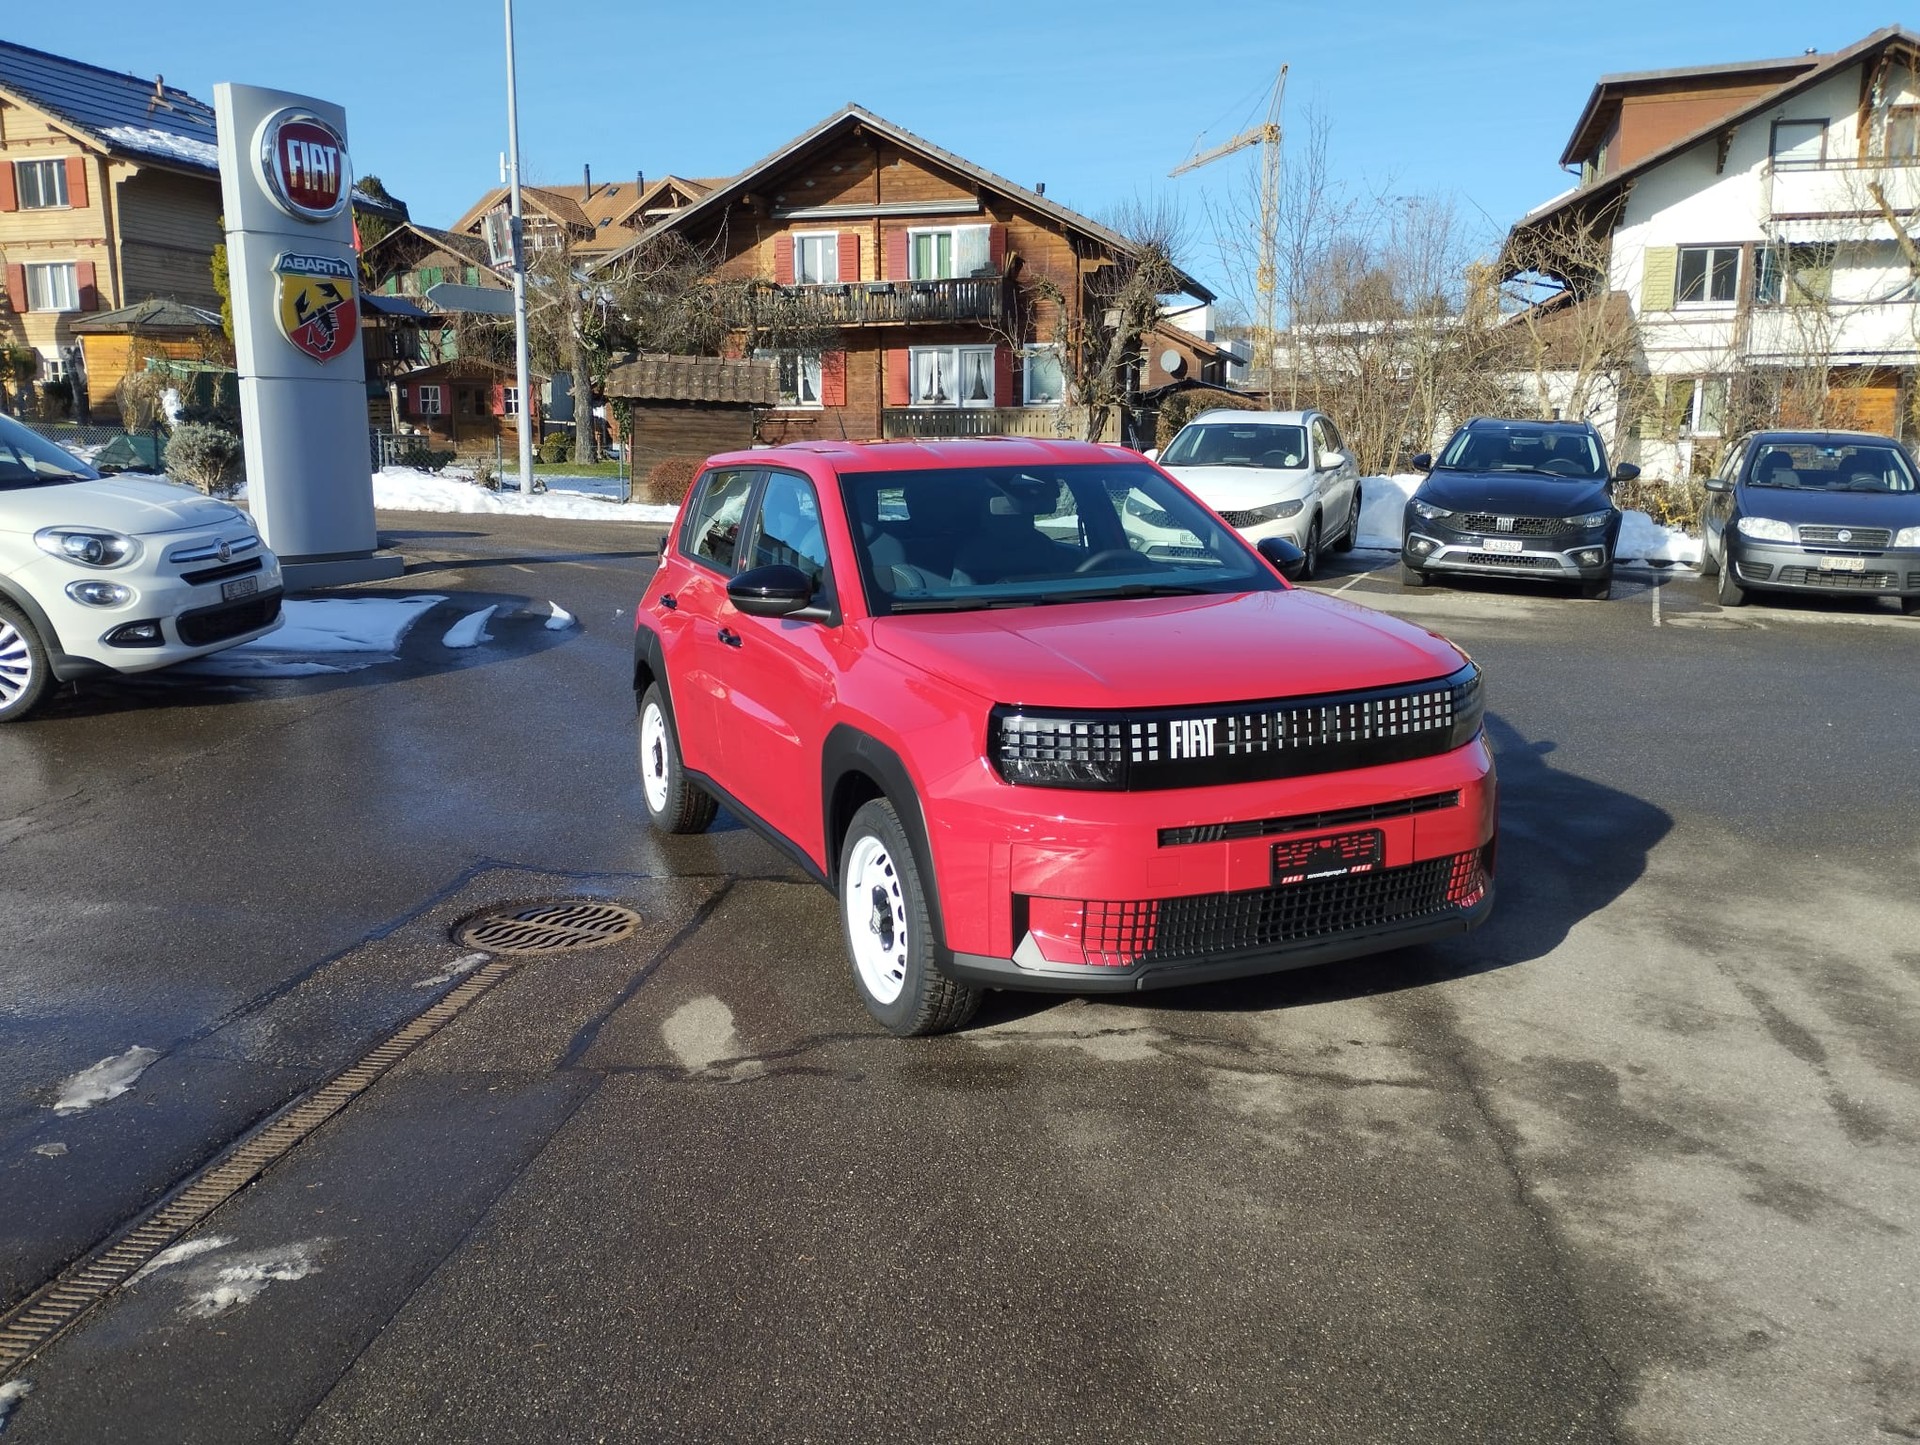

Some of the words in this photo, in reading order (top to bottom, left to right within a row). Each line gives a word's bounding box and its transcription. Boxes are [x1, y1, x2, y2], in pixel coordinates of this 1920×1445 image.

[287, 139, 337, 194] FIAT
[282, 258, 349, 276] ABARTH
[1496, 517, 1515, 531] FIAT
[1170, 718, 1217, 759] FIAT
